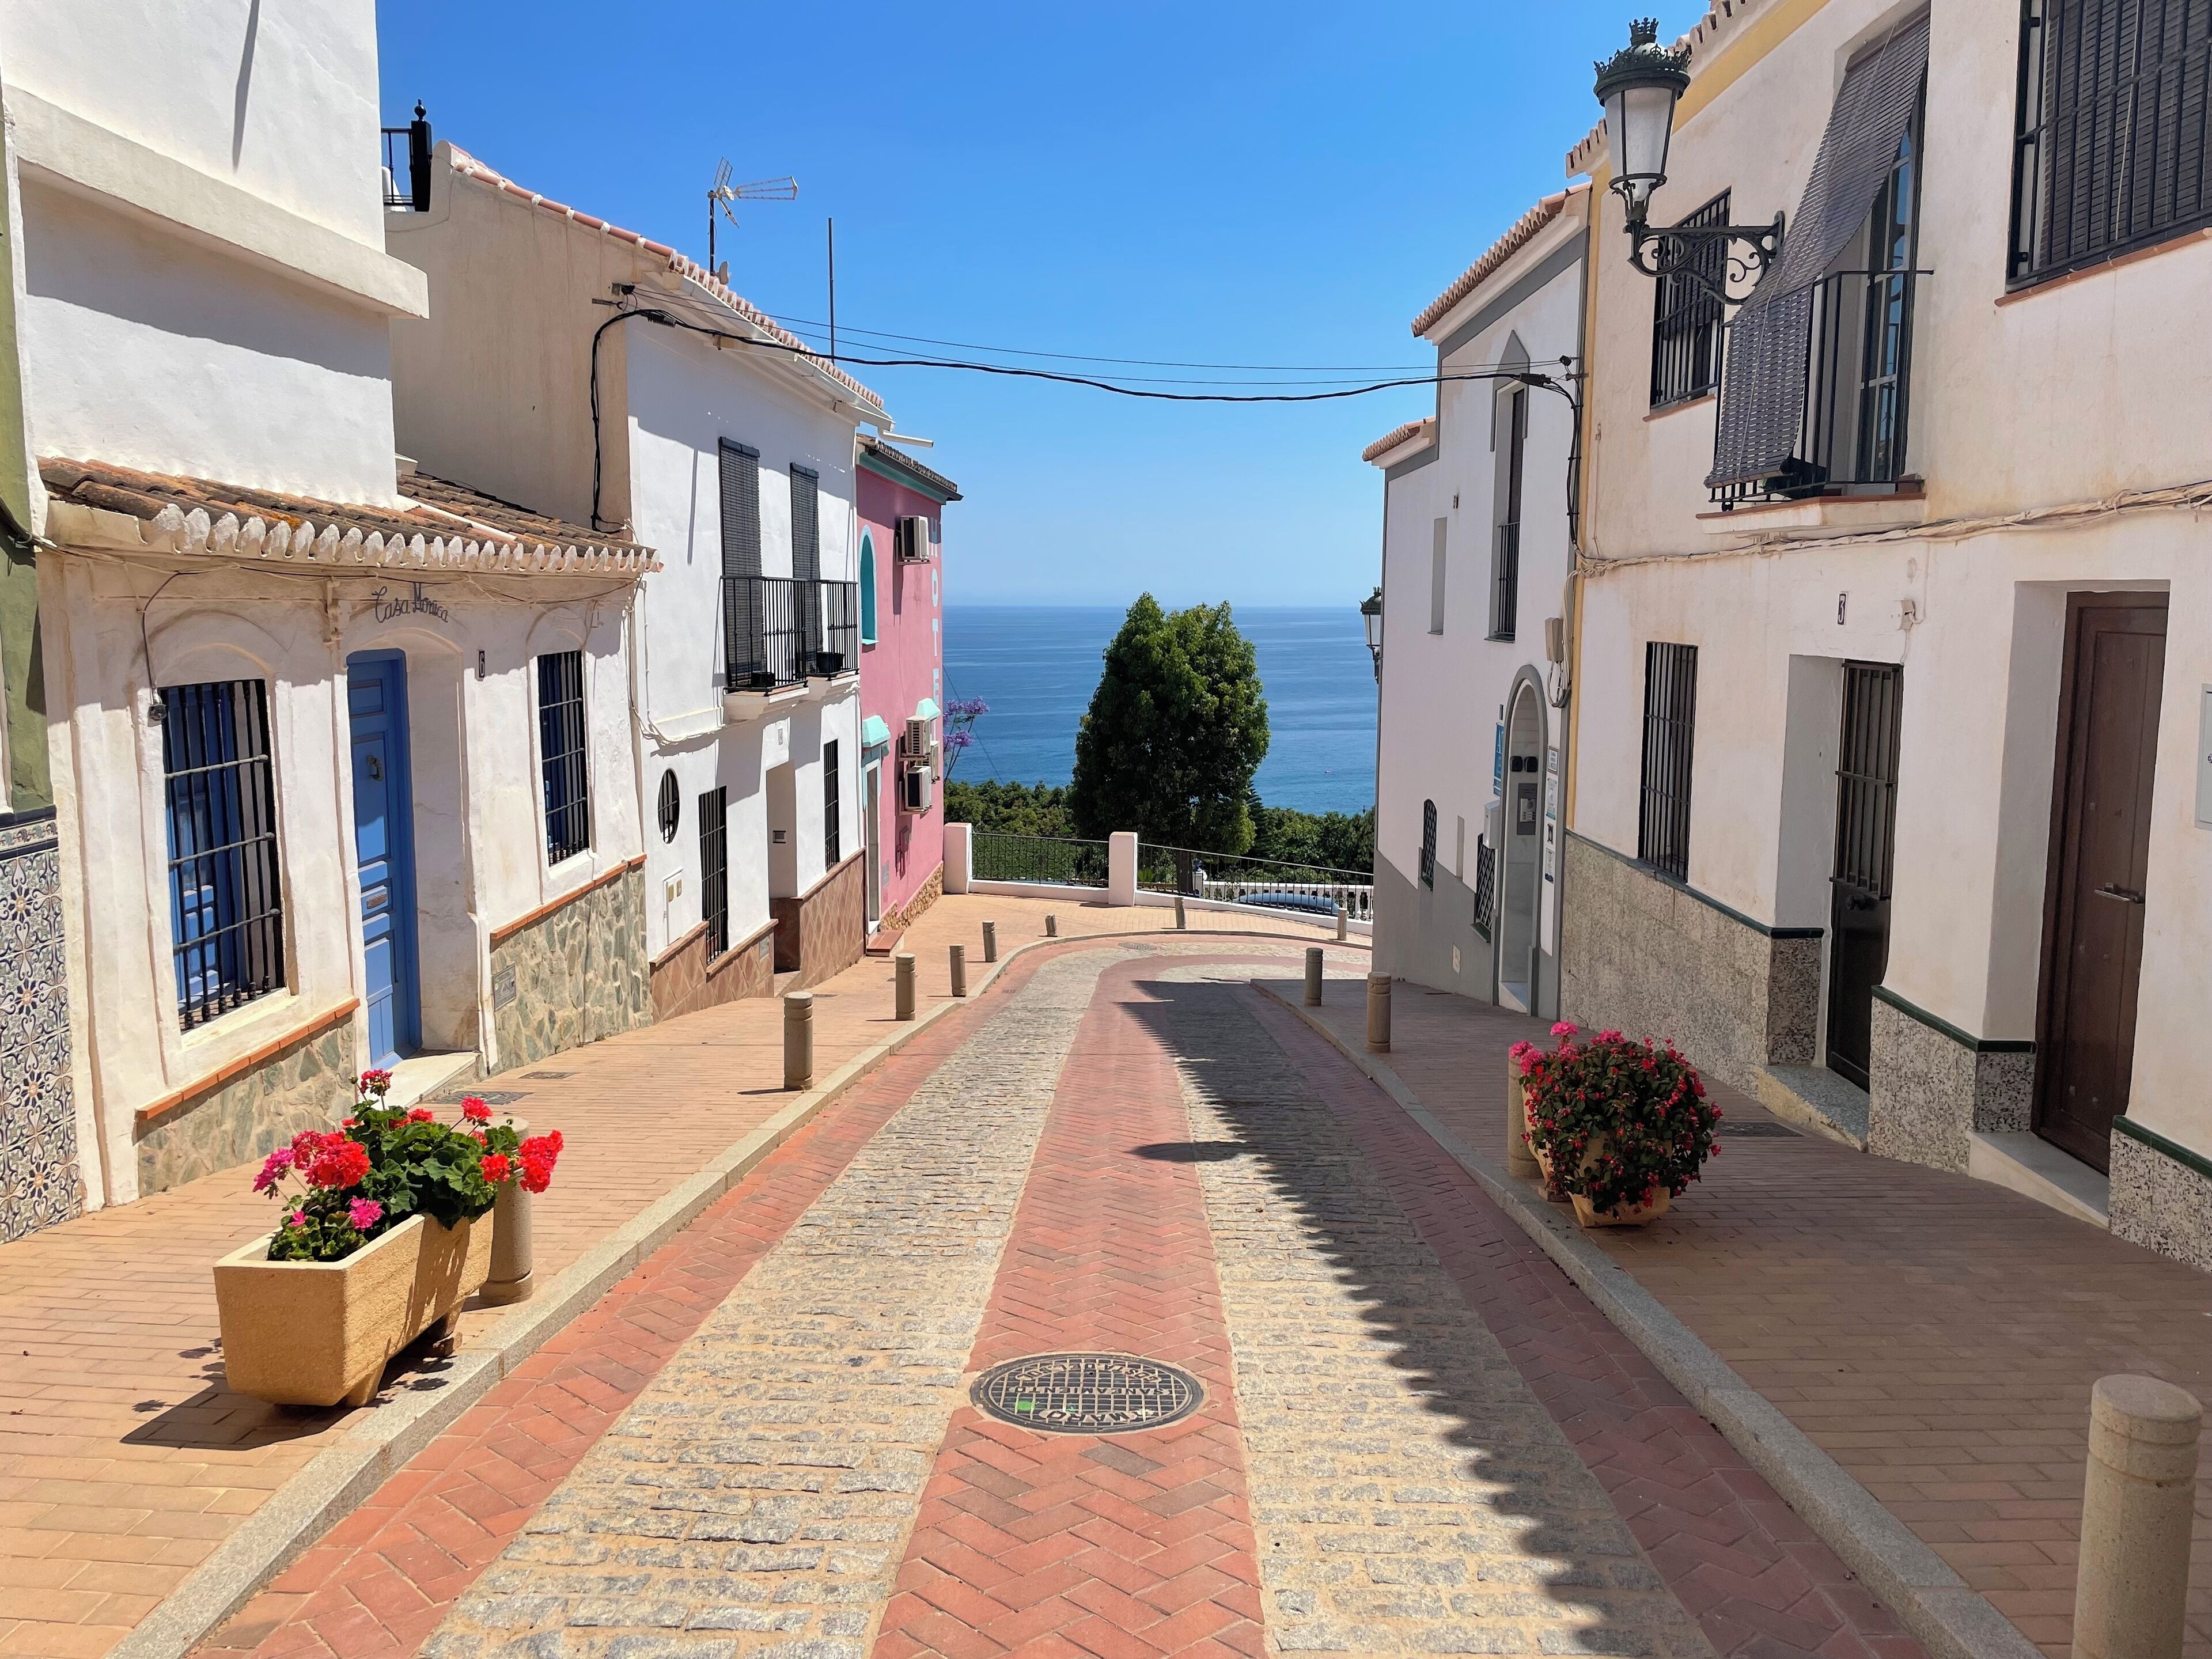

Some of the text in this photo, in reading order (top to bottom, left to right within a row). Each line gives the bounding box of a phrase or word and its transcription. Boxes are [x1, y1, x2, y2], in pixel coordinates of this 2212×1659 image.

[372, 585, 410, 623] Casa
[1838, 595, 1845, 623] 3
[479, 653, 484, 676] 6
[1014, 1387, 1164, 1395] SANEAMIENTO
[1046, 1409, 1130, 1422] MARO
